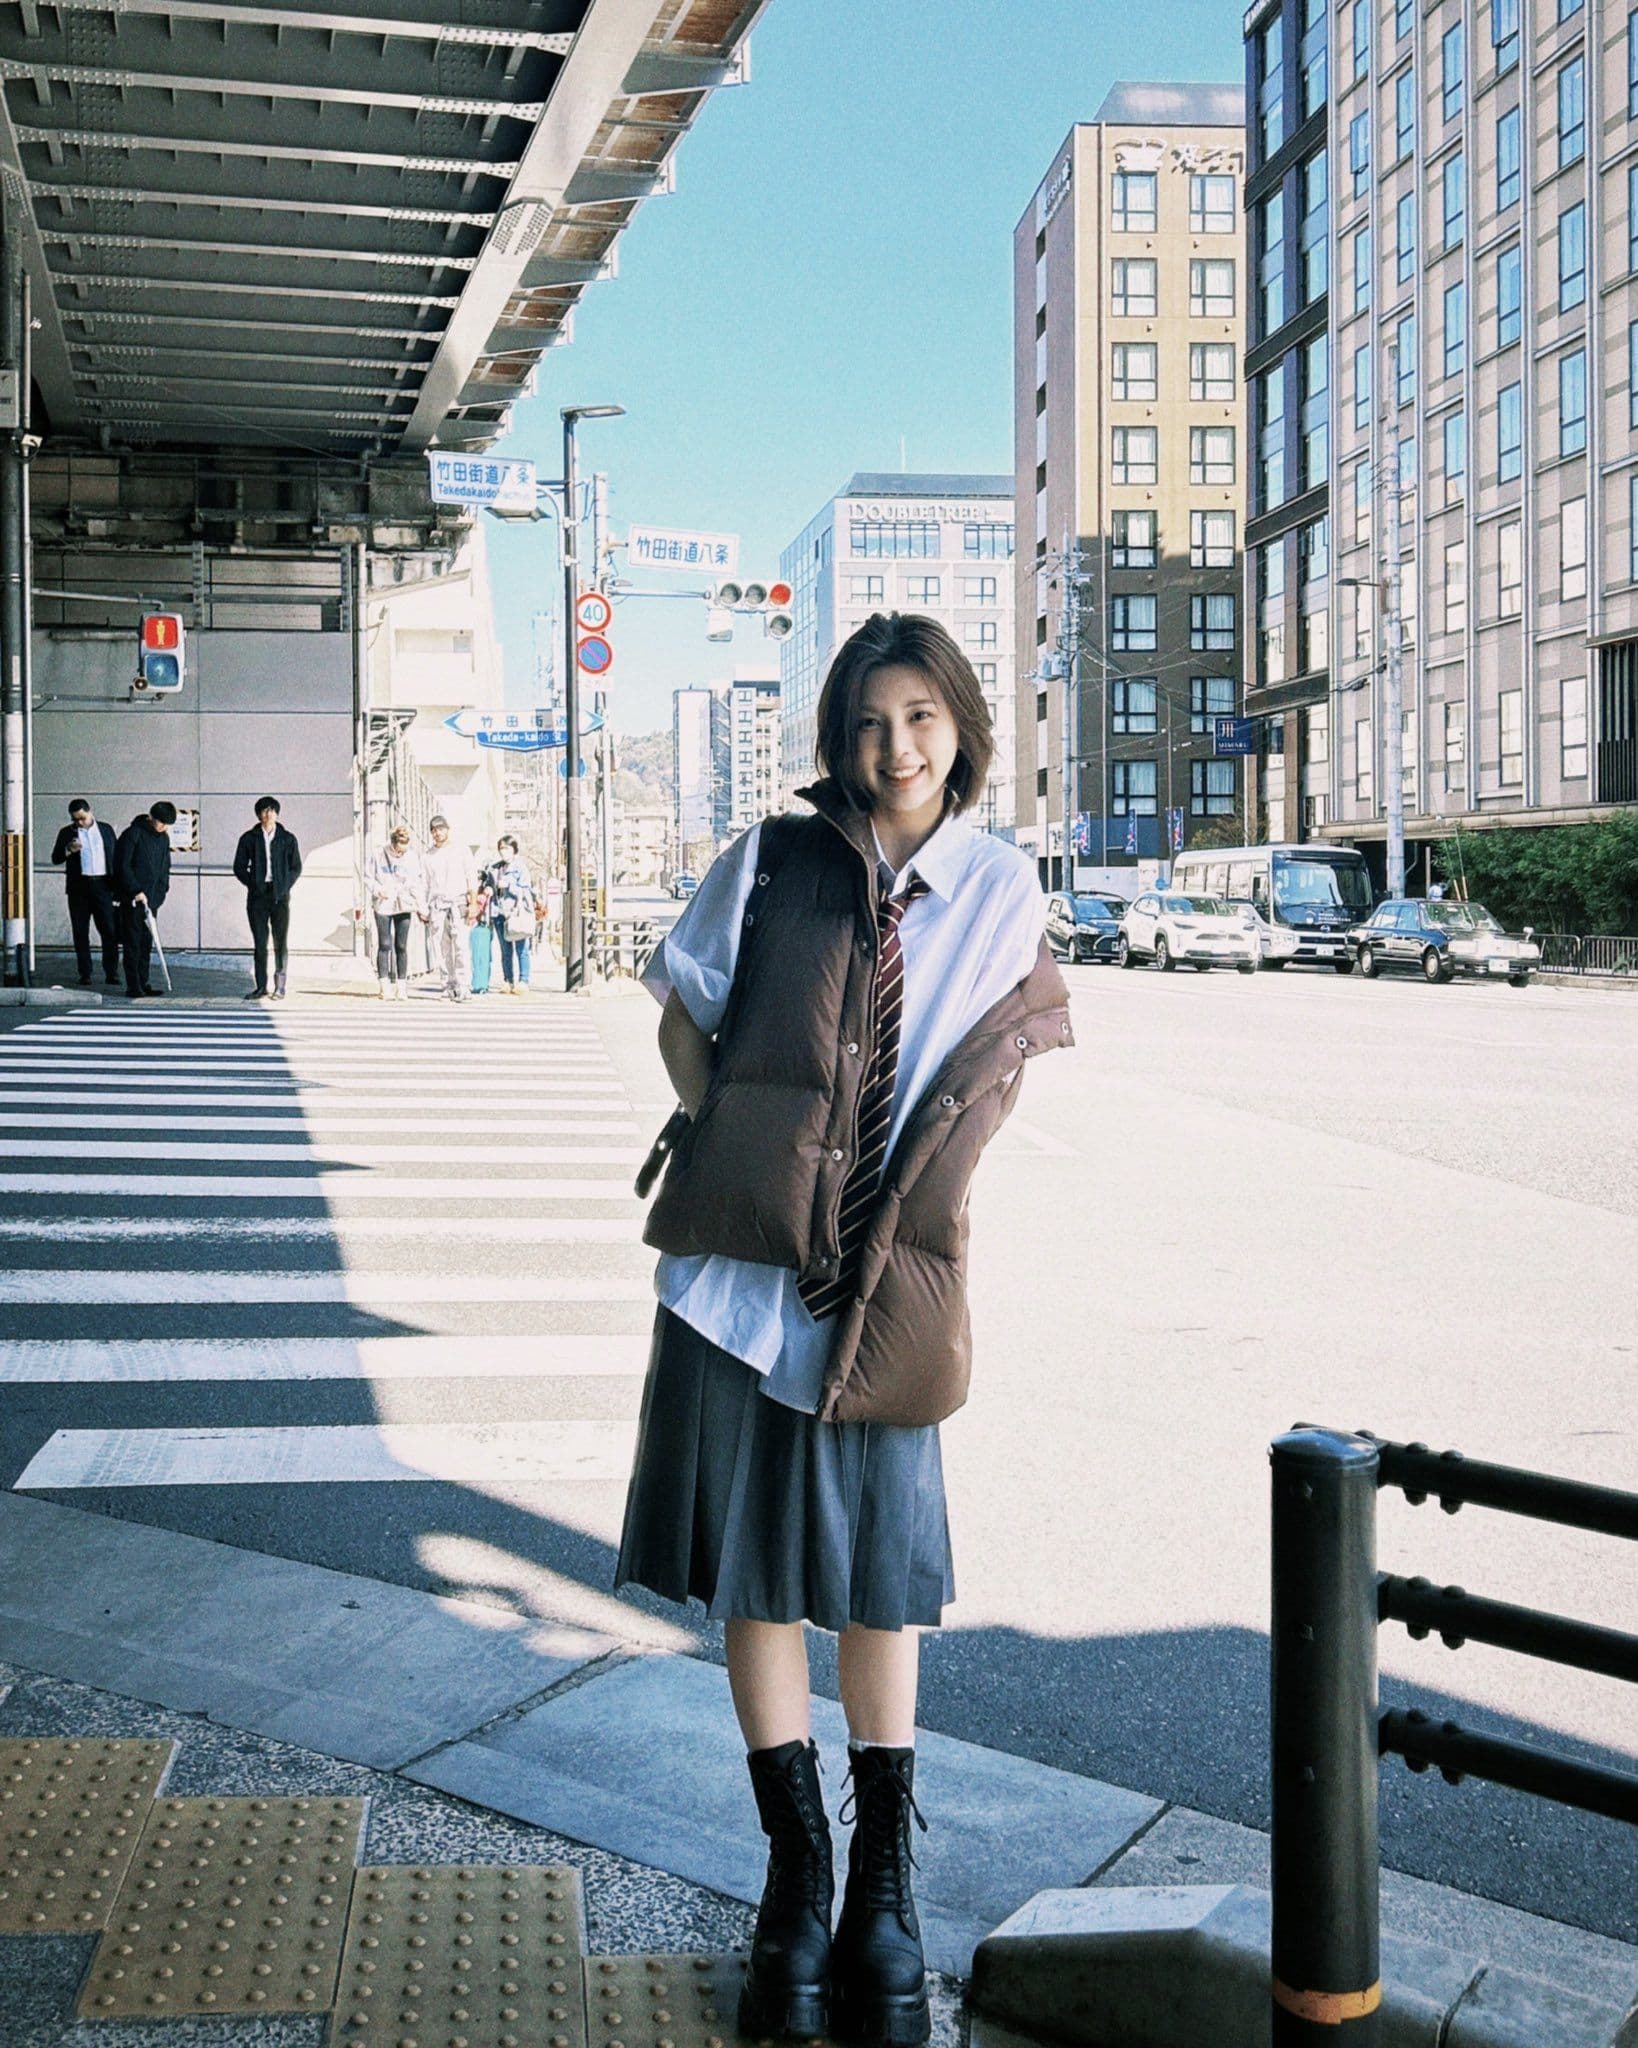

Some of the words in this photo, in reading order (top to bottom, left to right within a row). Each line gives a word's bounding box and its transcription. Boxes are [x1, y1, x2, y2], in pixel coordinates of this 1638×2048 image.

[637, 535, 728, 565] 竹田街道八条
[583, 604, 603, 621] 40
